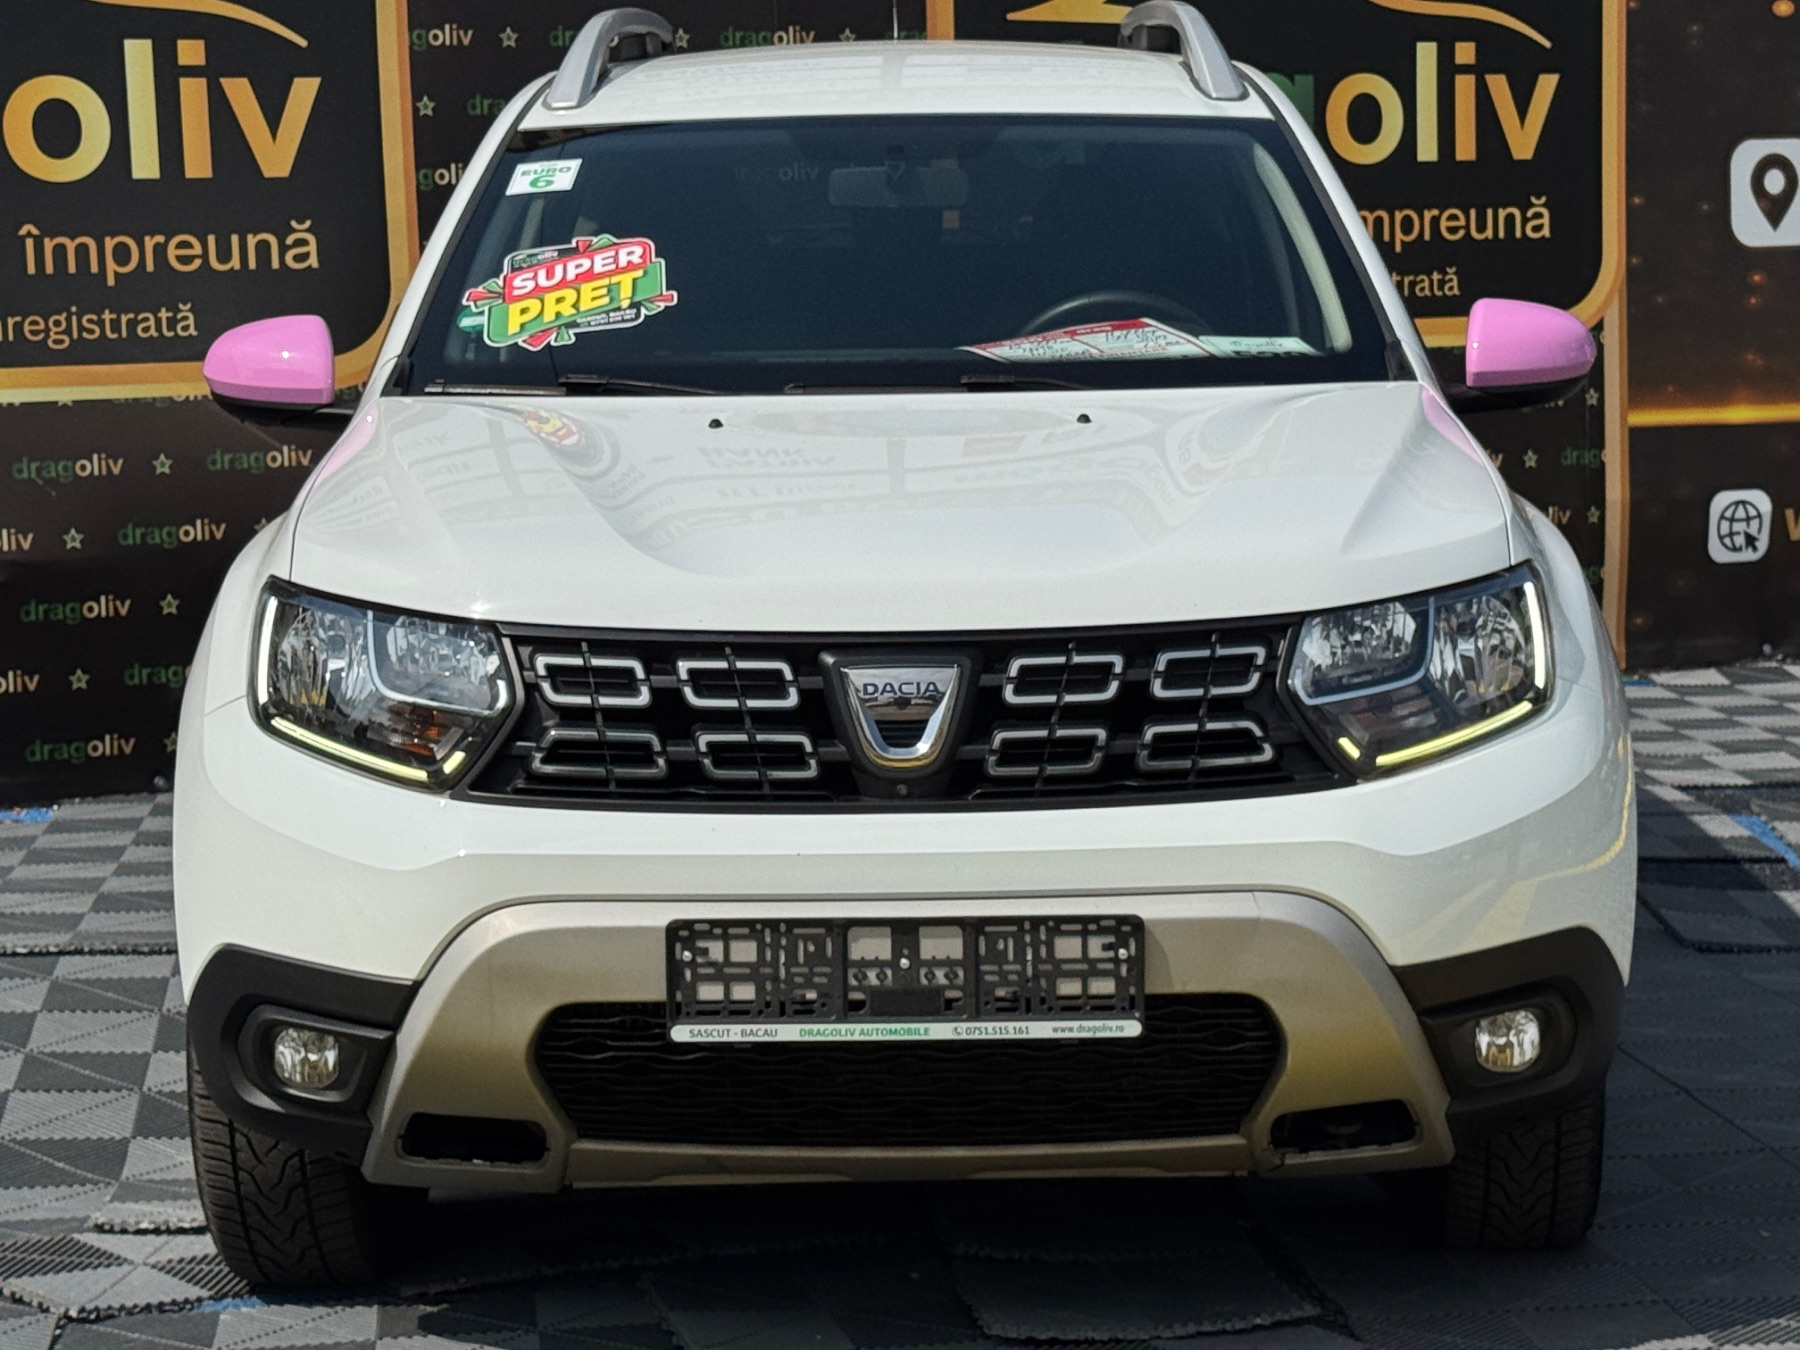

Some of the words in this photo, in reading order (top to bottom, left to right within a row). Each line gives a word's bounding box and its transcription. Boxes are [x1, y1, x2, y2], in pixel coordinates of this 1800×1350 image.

[521, 166, 572, 177] EURO
[529, 174, 556, 189] 6
[17, 219, 320, 287] împreună
[512, 244, 644, 297] SUPER
[508, 269, 645, 336] PREȚ
[12, 452, 124, 482] dragoliv
[206, 445, 313, 474] dragoliv
[118, 518, 227, 549] dragoliv
[20, 594, 132, 624] dragoliv
[862, 681, 941, 696] DACIA
[25, 733, 136, 764] dragoliv
[689, 1028, 731, 1038] SASCUT
[740, 1028, 778, 1038] BACAU
[799, 1027, 856, 1038] DRAGOLIV
[858, 1026, 930, 1037] AUTOMOBILE
[965, 1025, 1030, 1036] 0751.515.161
[1051, 1022, 1125, 1036] www.dragoliv.ro
